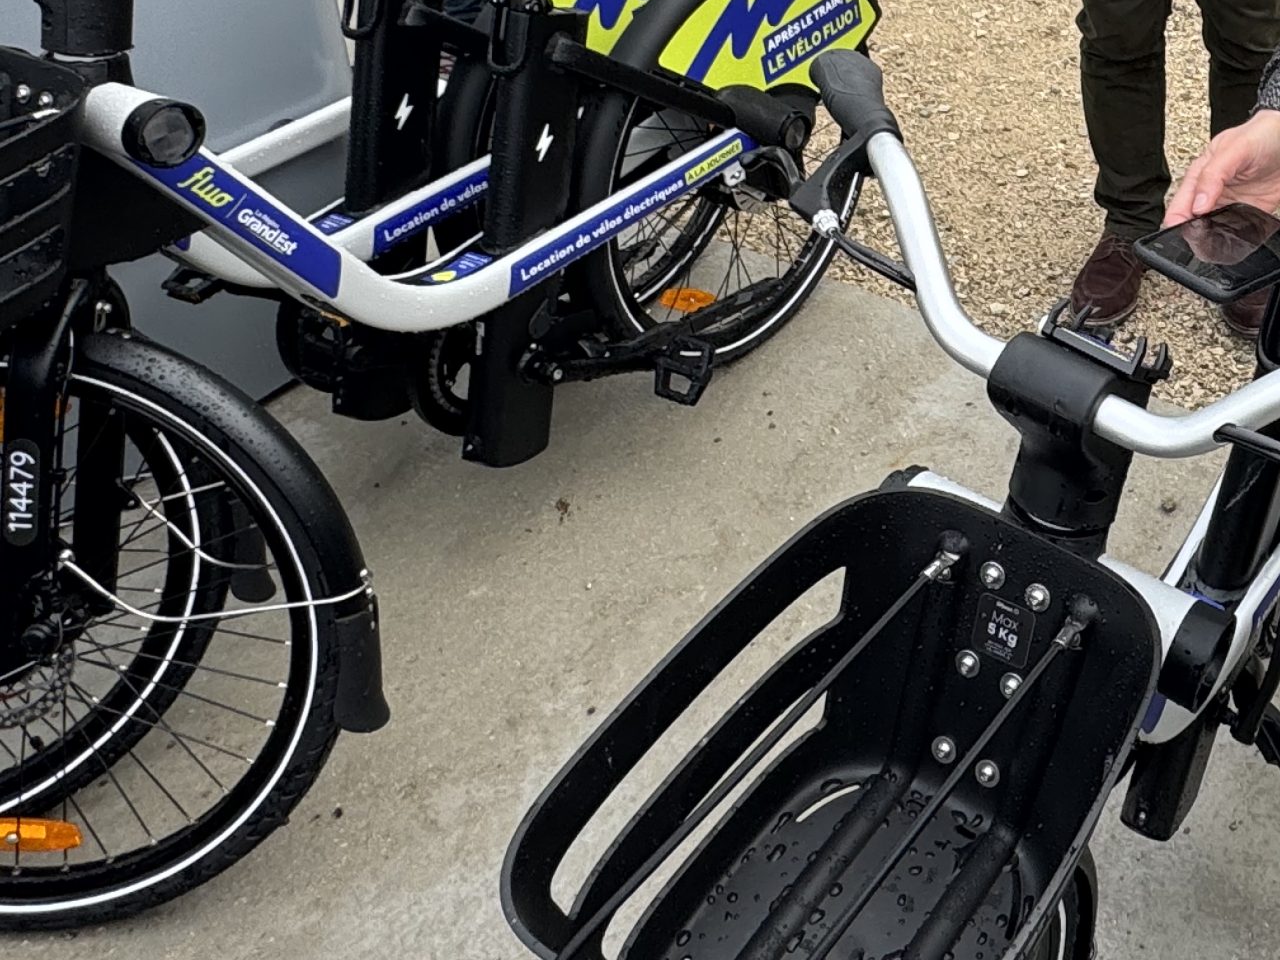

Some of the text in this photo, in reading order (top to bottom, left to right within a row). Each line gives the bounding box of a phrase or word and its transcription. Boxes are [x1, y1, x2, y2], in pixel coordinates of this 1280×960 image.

[768, 22, 801, 52] APRÈS
[800, 13, 814, 30] LE
[768, 52, 786, 75] LE
[786, 30, 822, 62] VÉLO
[822, 9, 854, 40] FLUO
[176, 166, 234, 208] fluo
[694, 164, 707, 178] LA
[706, 140, 742, 172] JOURNÉE
[384, 180, 489, 242] Location de vélos
[520, 244, 575, 282] Location
[575, 234, 592, 249] de
[592, 216, 623, 240] vélos
[622, 178, 684, 221] électriques
[8, 450, 36, 532] 114479
